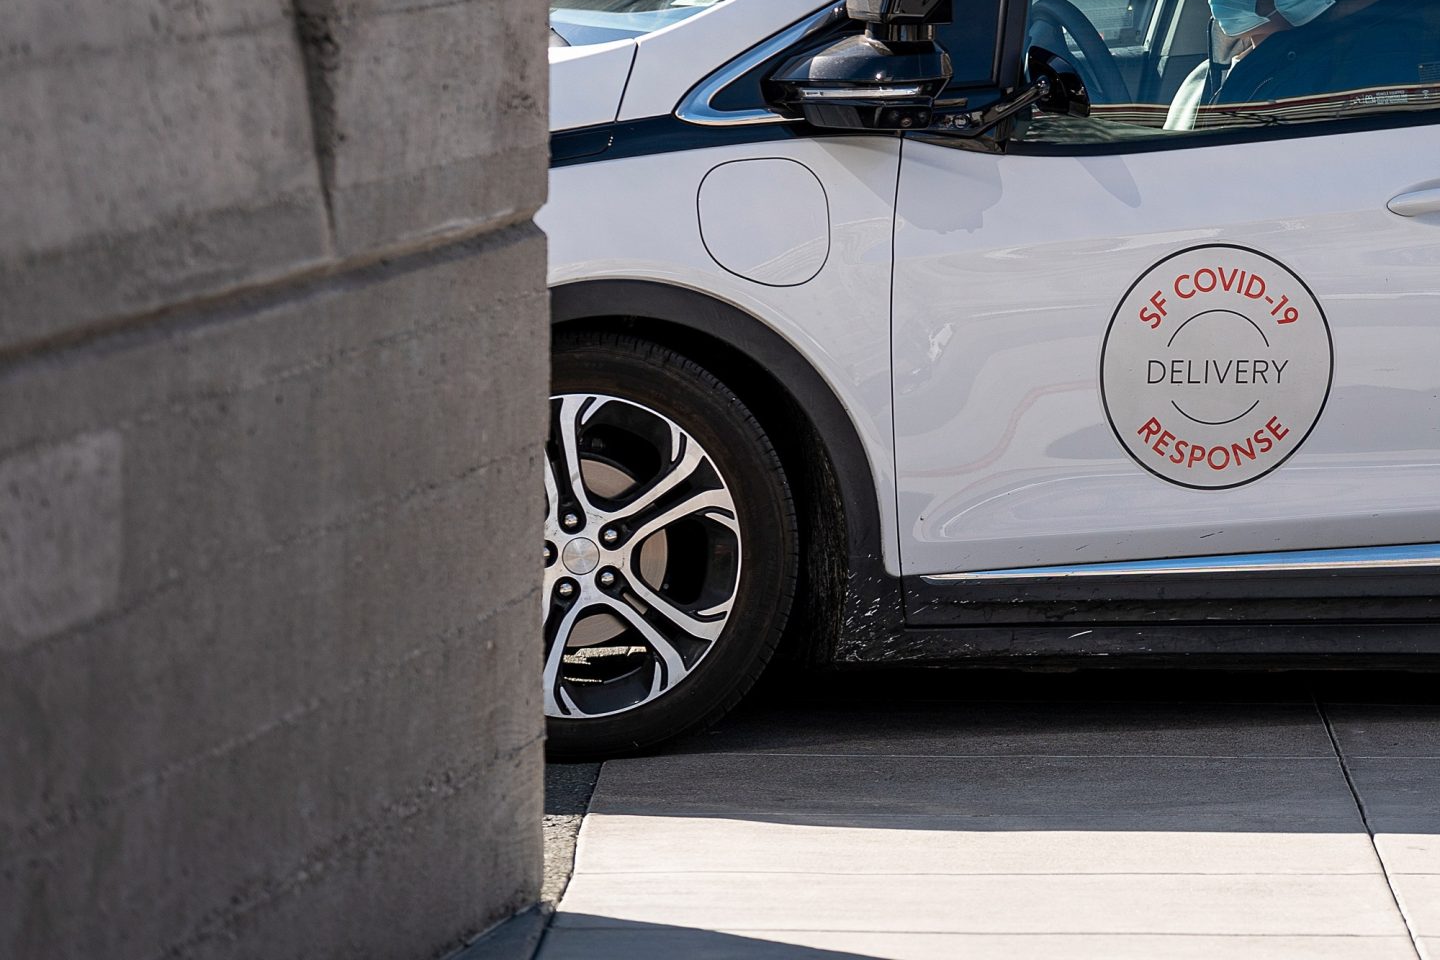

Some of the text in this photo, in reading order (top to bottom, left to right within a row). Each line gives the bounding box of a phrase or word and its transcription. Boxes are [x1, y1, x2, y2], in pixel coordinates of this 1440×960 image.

[1138, 266, 1300, 330] SF COVID-19
[1147, 359, 1289, 385] DELIVERY
[1136, 415, 1291, 471] RESPONSE
